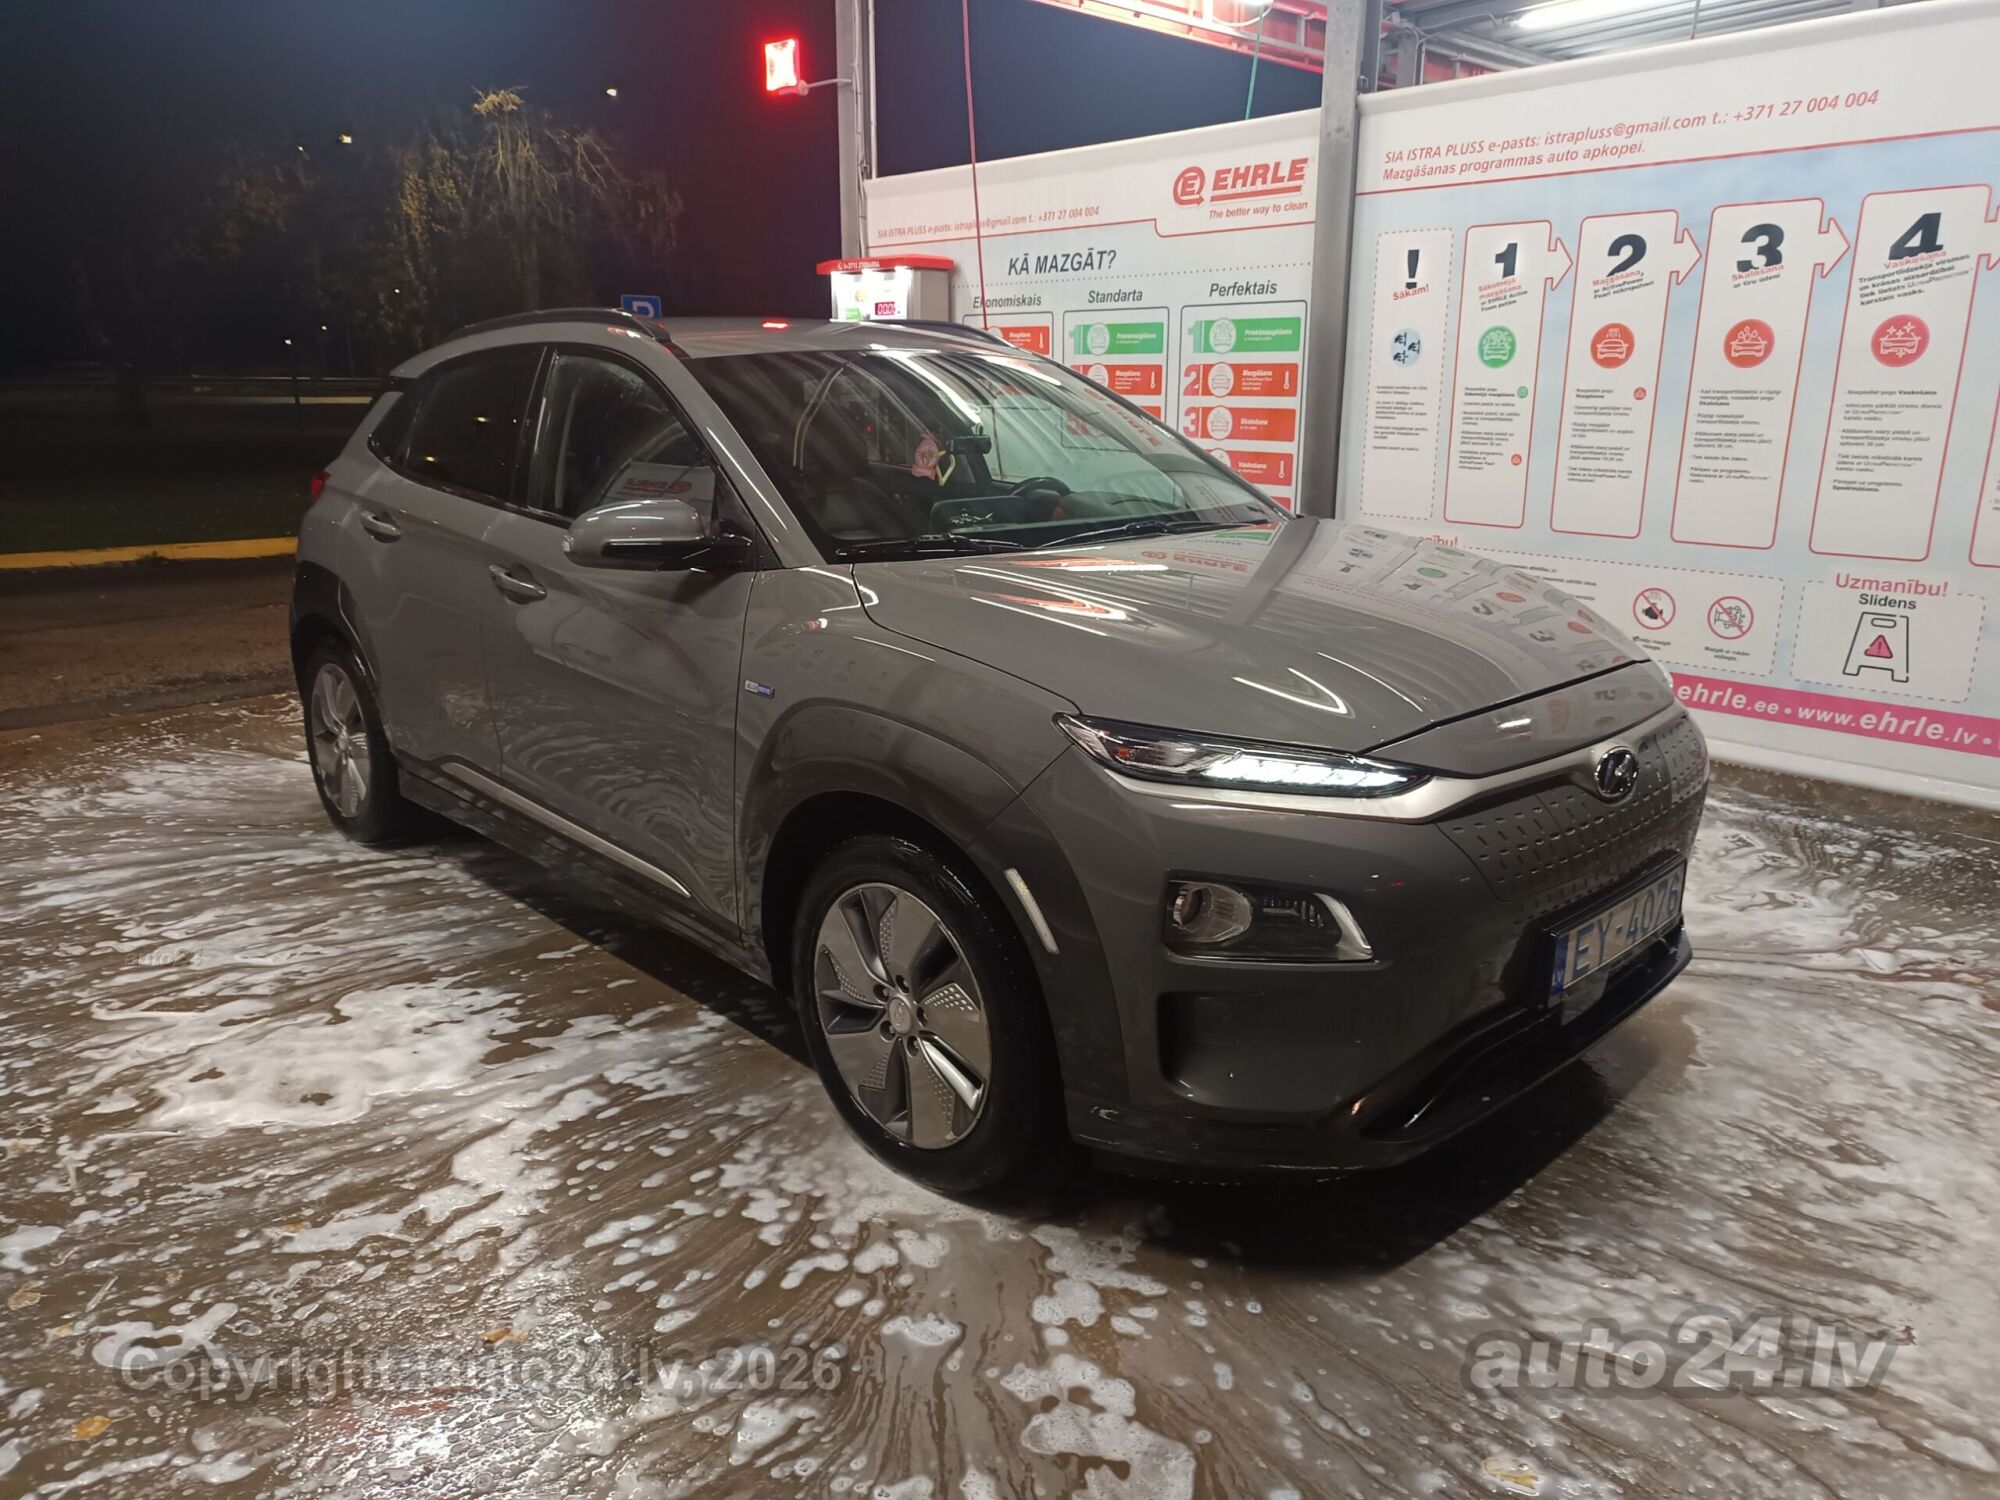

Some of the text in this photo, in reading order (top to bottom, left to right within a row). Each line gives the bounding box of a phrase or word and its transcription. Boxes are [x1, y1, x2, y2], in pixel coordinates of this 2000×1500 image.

[1385, 90, 1879, 164] SIA ISTRA PLUSS e-pasts: istrapluss@gmail.com t.: +371 27 004 004
[1212, 157, 1309, 191] EHRLE
[1383, 140, 1646, 181] Mazgāšanas programmas auto apkopei.
[1058, 209, 1067, 220] 27
[1069, 208, 1083, 219] 004
[1085, 206, 1099, 217] 004
[1209, 202, 1308, 219] The better way to clean
[1736, 223, 1785, 273] 3
[1888, 212, 1944, 261] 4
[1008, 248, 1117, 276] KĀ MAZGĀT?
[1495, 243, 1518, 279] 1
[1606, 233, 1647, 277] 2
[1088, 289, 1144, 304] Standarta
[1209, 280, 1278, 298] Perfektais
[1835, 572, 1949, 598] Uzmanību!
[1858, 593, 1917, 610] Slidens
[1798, 706, 1978, 745] www.ehrle.lv
